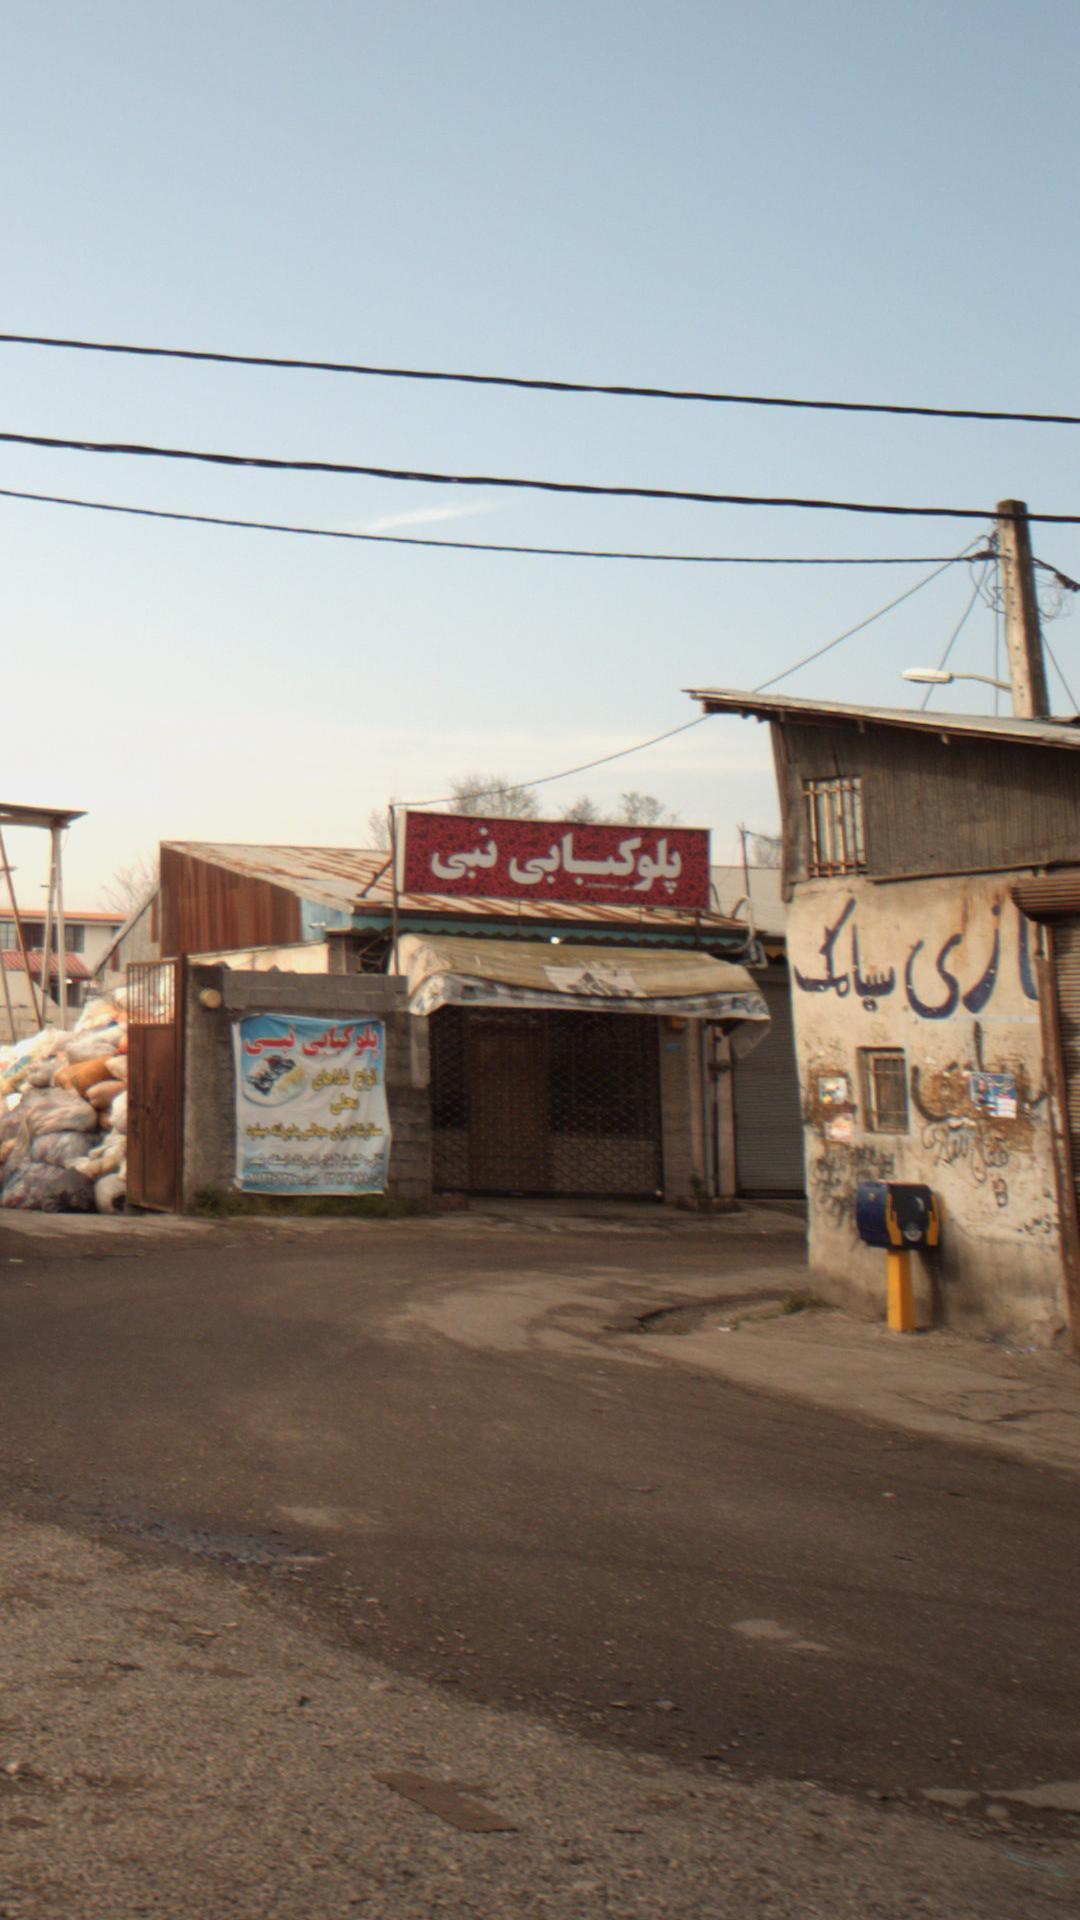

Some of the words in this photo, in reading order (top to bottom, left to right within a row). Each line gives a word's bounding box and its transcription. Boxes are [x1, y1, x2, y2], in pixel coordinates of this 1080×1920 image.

[430, 827, 498, 880] نبی
[794, 896, 896, 1012] سیامک
[244, 1023, 296, 1056] نبی
